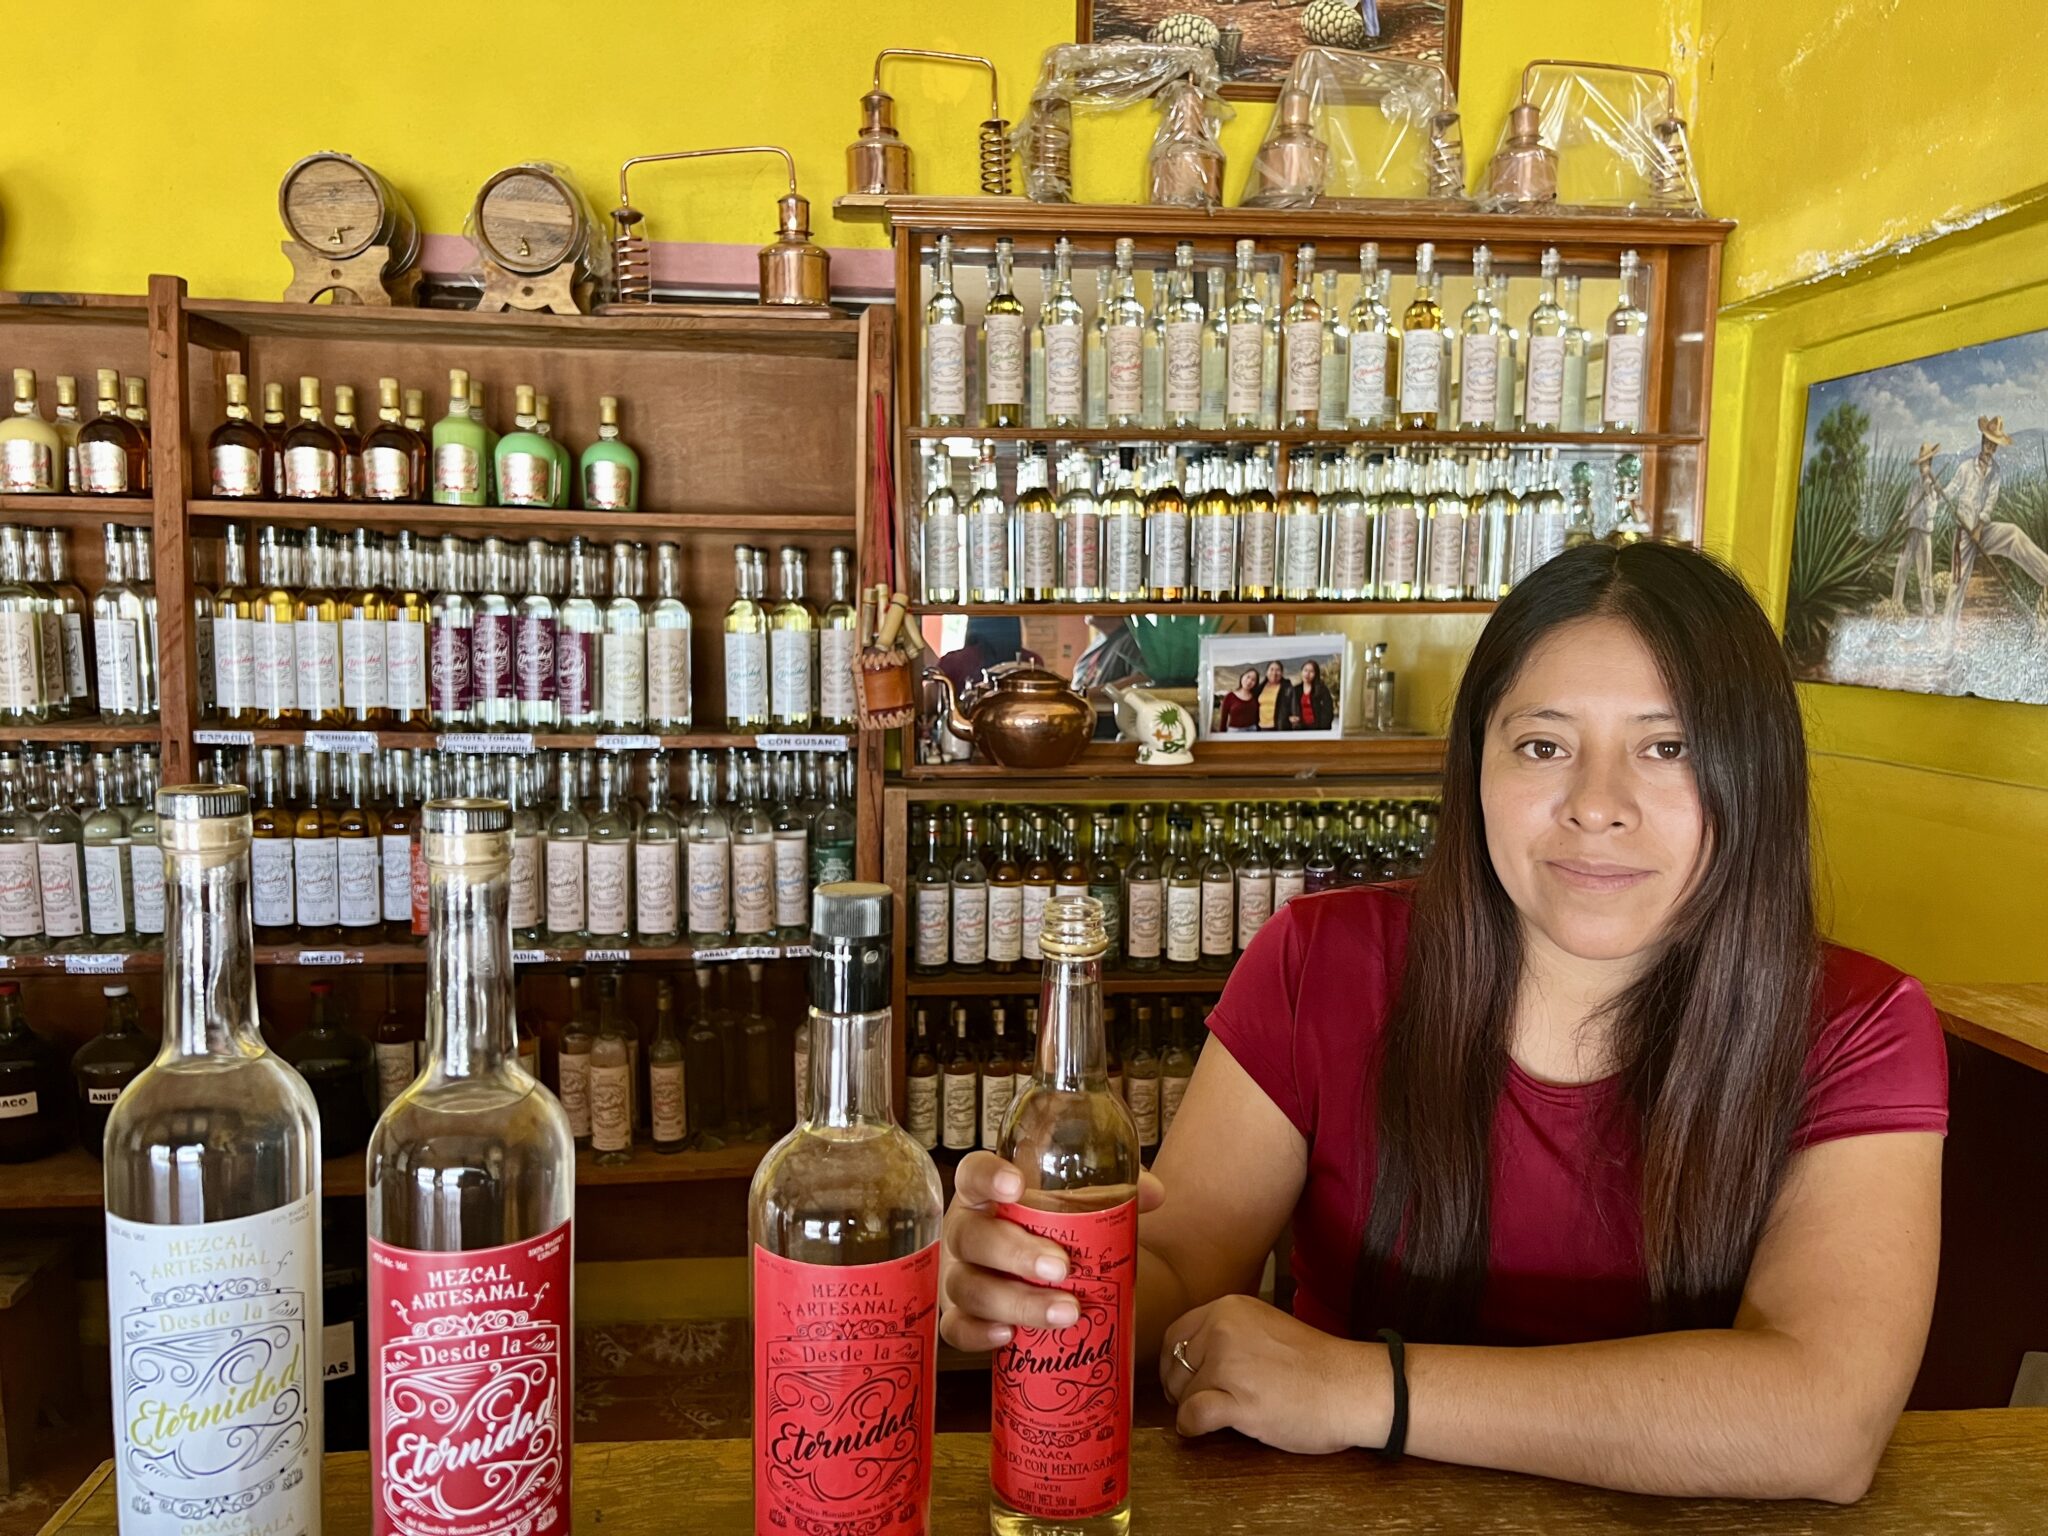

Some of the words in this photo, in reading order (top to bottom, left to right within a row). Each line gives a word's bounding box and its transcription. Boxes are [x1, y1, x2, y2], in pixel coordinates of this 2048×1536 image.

[0, 1097, 28, 1109] ACO
[167, 1233, 253, 1258] MEZCAL
[150, 1250, 270, 1280] ARTESANAL
[427, 1263, 511, 1289] MEZCAL
[411, 1281, 529, 1311] ARTESANAL
[811, 1281, 883, 1298] MEZCAL
[159, 1303, 231, 1334] Desde
[243, 1302, 263, 1321] la
[796, 1299, 898, 1318] ARTESANAL
[418, 1339, 490, 1366] Desde
[501, 1336, 521, 1356] la
[801, 1343, 863, 1363] Desde
[873, 1342, 891, 1360] la
[129, 1343, 299, 1452] Eternidad
[388, 1376, 556, 1491] Eternidad
[771, 1384, 919, 1473] Eternidad
[1021, 1444, 1073, 1461] OAXACA
[1024, 1458, 1048, 1474] CON
[181, 1513, 253, 1536] OAXACA
